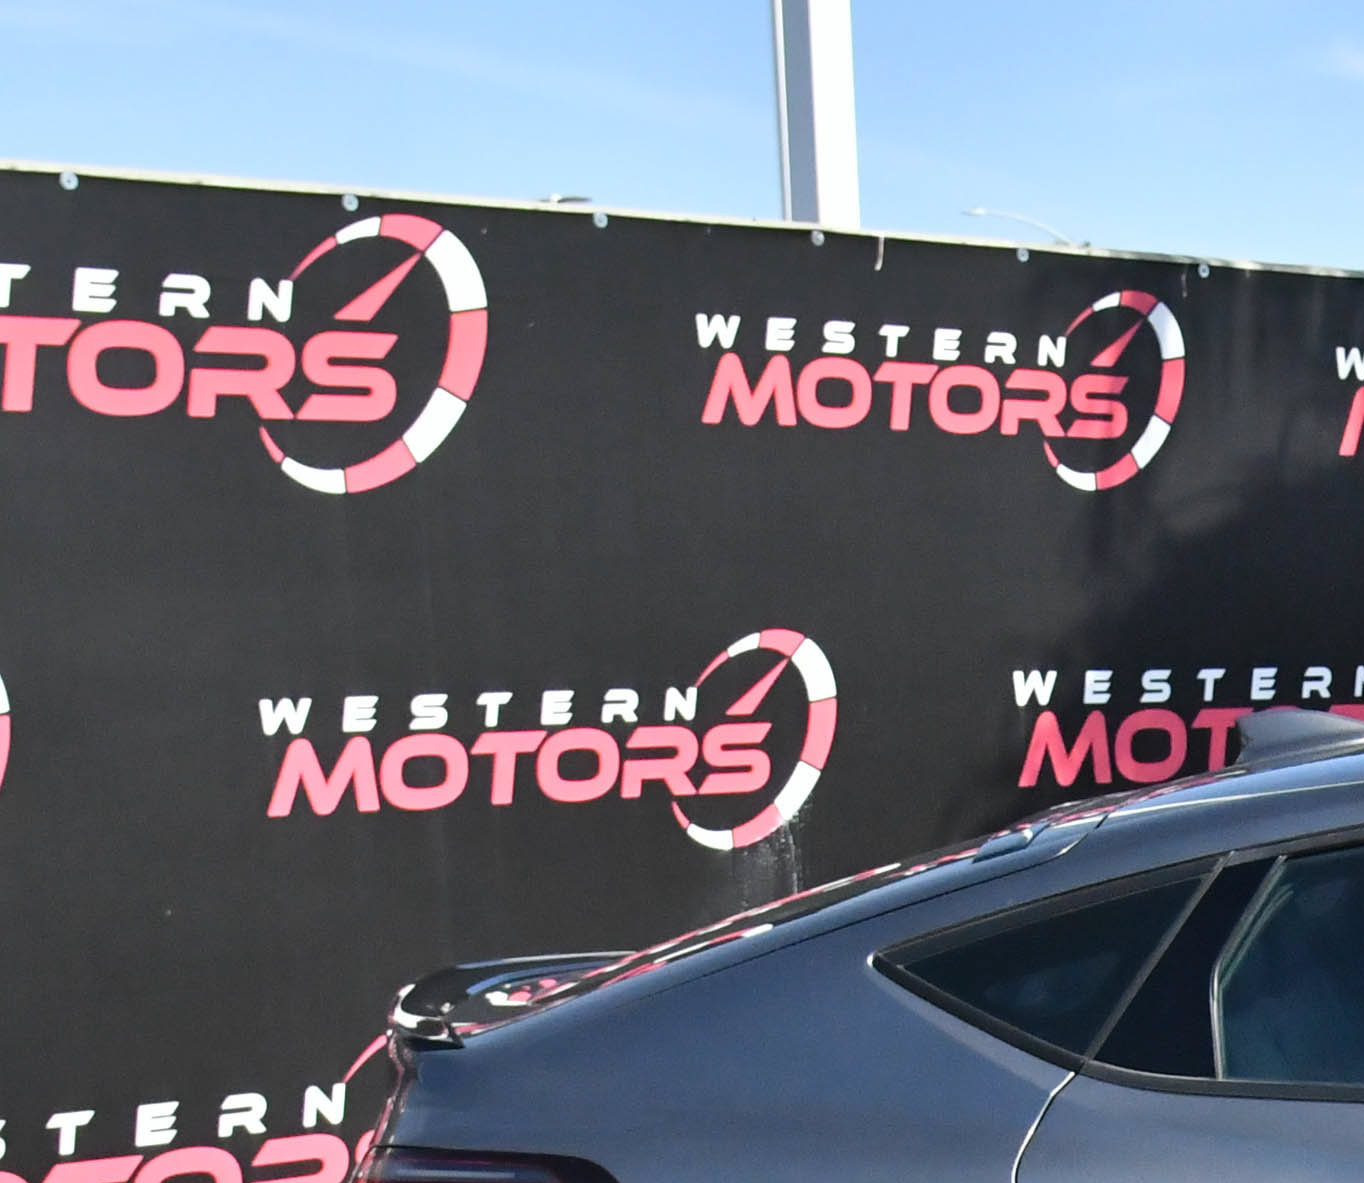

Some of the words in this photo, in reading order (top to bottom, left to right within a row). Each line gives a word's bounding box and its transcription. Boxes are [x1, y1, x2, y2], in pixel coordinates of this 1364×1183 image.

[0, 314, 399, 422] TORS
[696, 313, 1067, 368] WESTERN
[701, 352, 1129, 440] MOTORS
[258, 686, 697, 735] WESTERN
[267, 720, 773, 818] MOTORS
[0, 1083, 346, 1162] TERN
